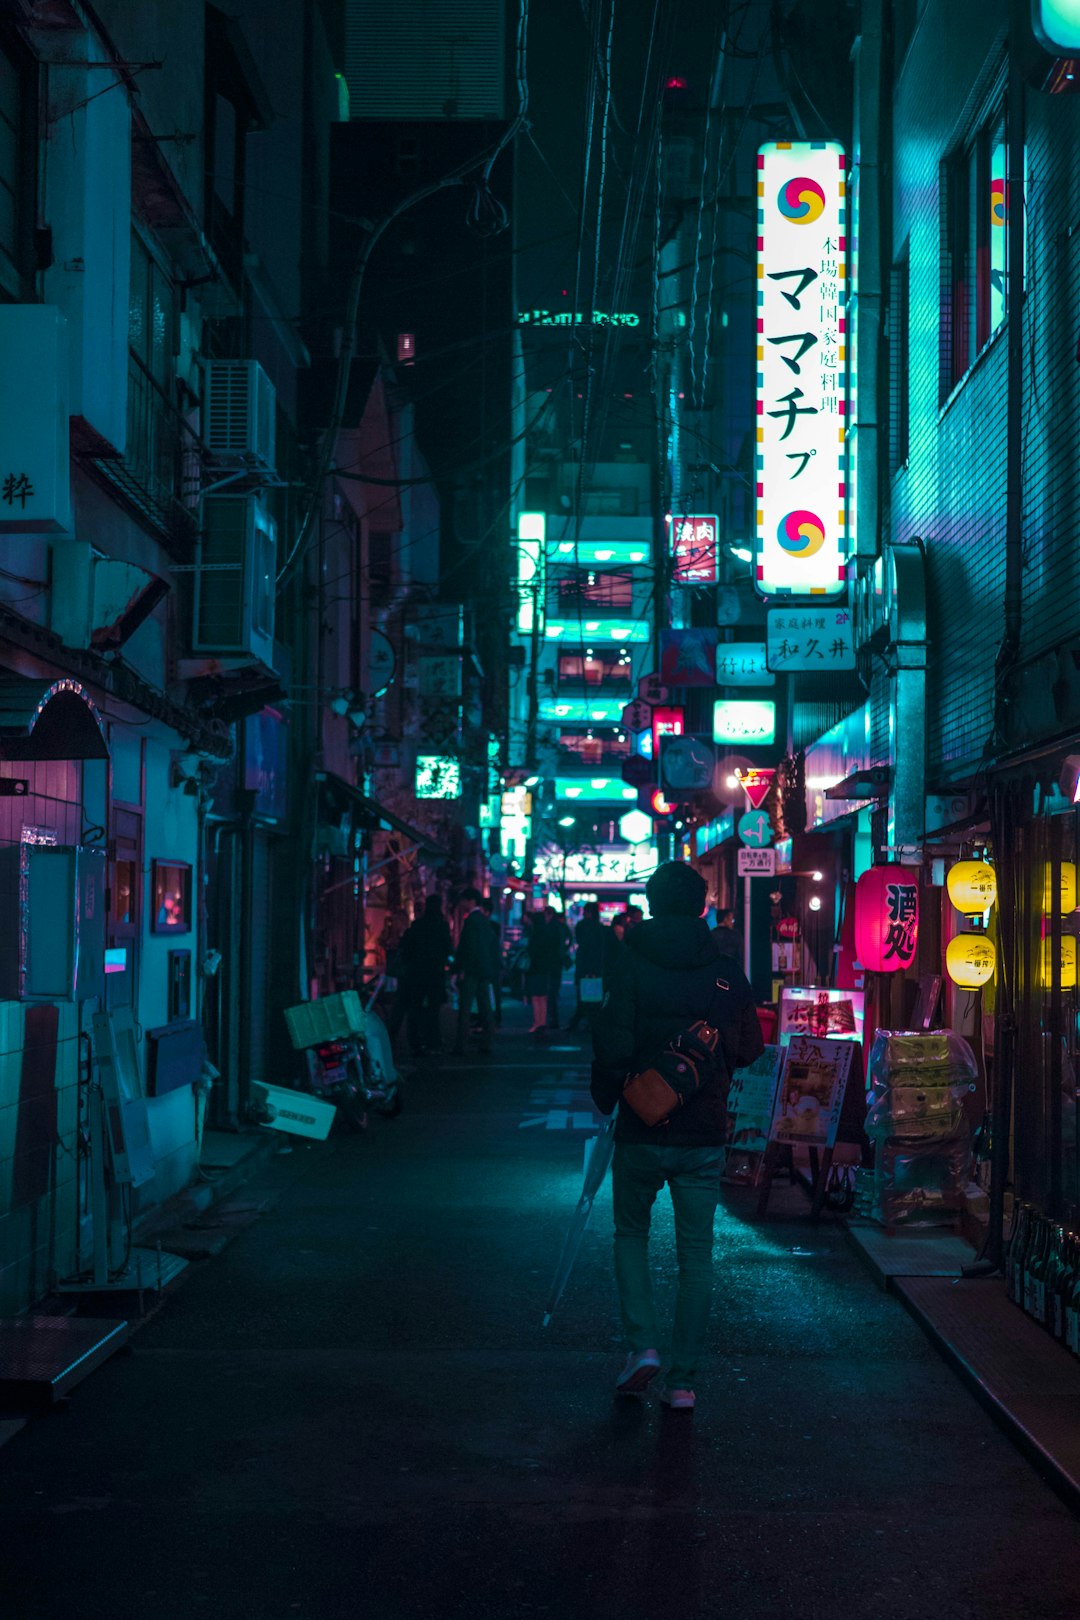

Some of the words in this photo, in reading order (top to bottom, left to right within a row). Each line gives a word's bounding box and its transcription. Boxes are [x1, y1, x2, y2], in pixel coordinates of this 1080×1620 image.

[819, 236, 838, 414] 本場韓国家庭料理
[766, 267, 819, 480] ママチプ
[2, 473, 34, 509] 粋
[773, 617, 826, 631] 家庭料理
[777, 637, 850, 660] 和久井
[883, 884, 918, 961] 酒処
